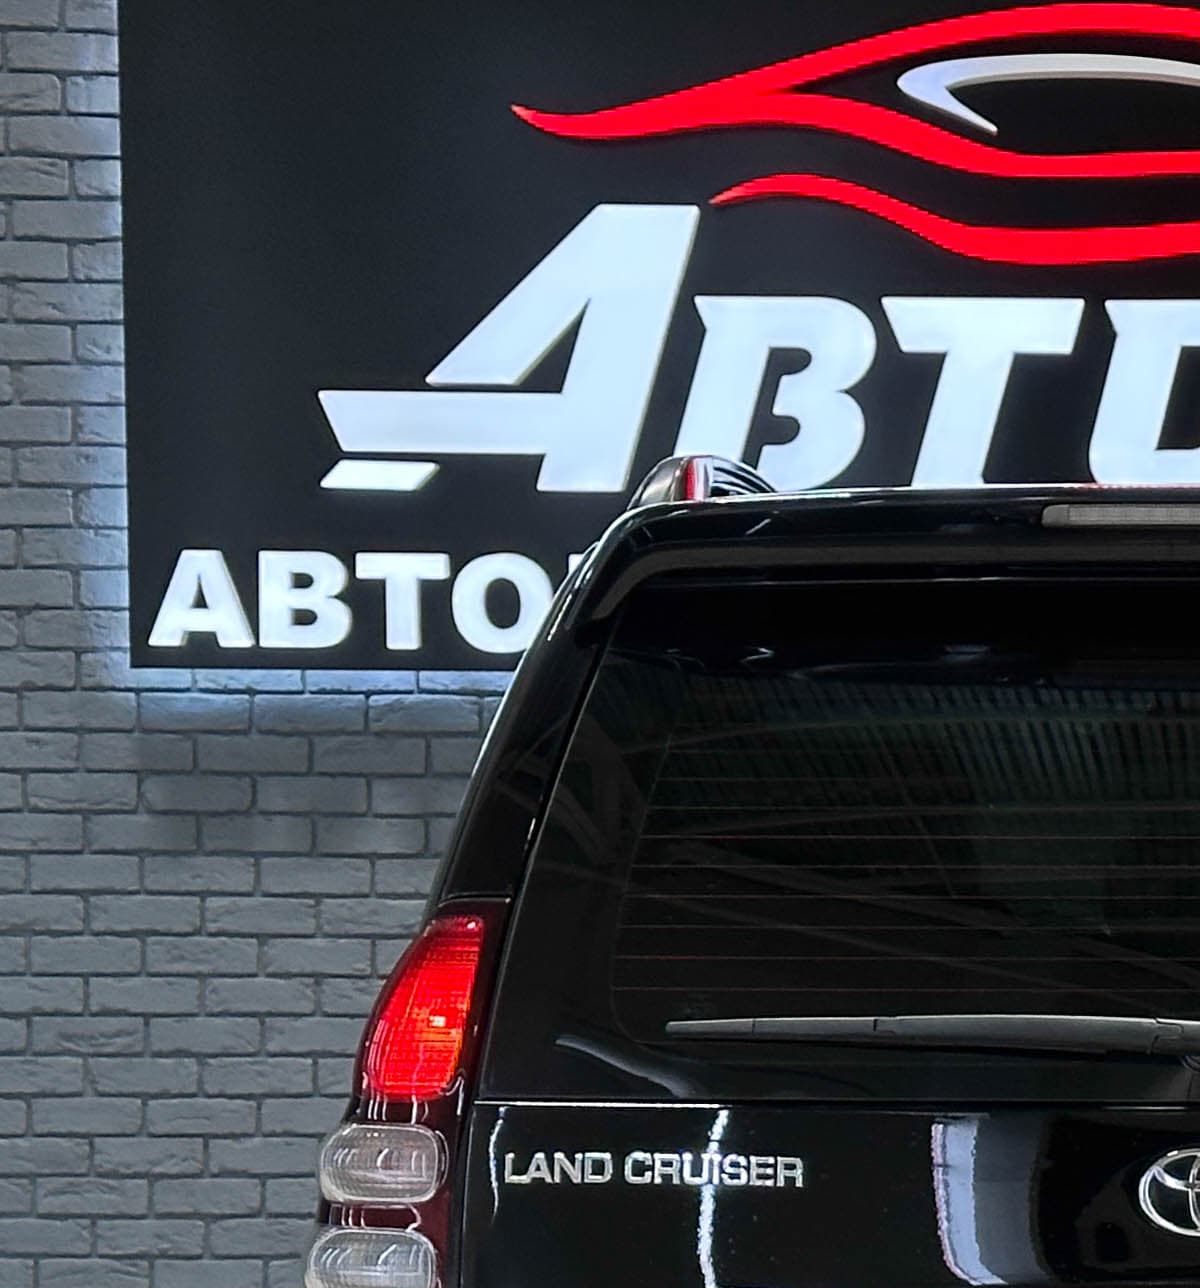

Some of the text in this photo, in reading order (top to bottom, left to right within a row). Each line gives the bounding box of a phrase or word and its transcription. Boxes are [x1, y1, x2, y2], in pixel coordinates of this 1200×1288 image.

[147, 549, 598, 653] АВТО
[504, 1151, 804, 1188] LAND CRUISER
